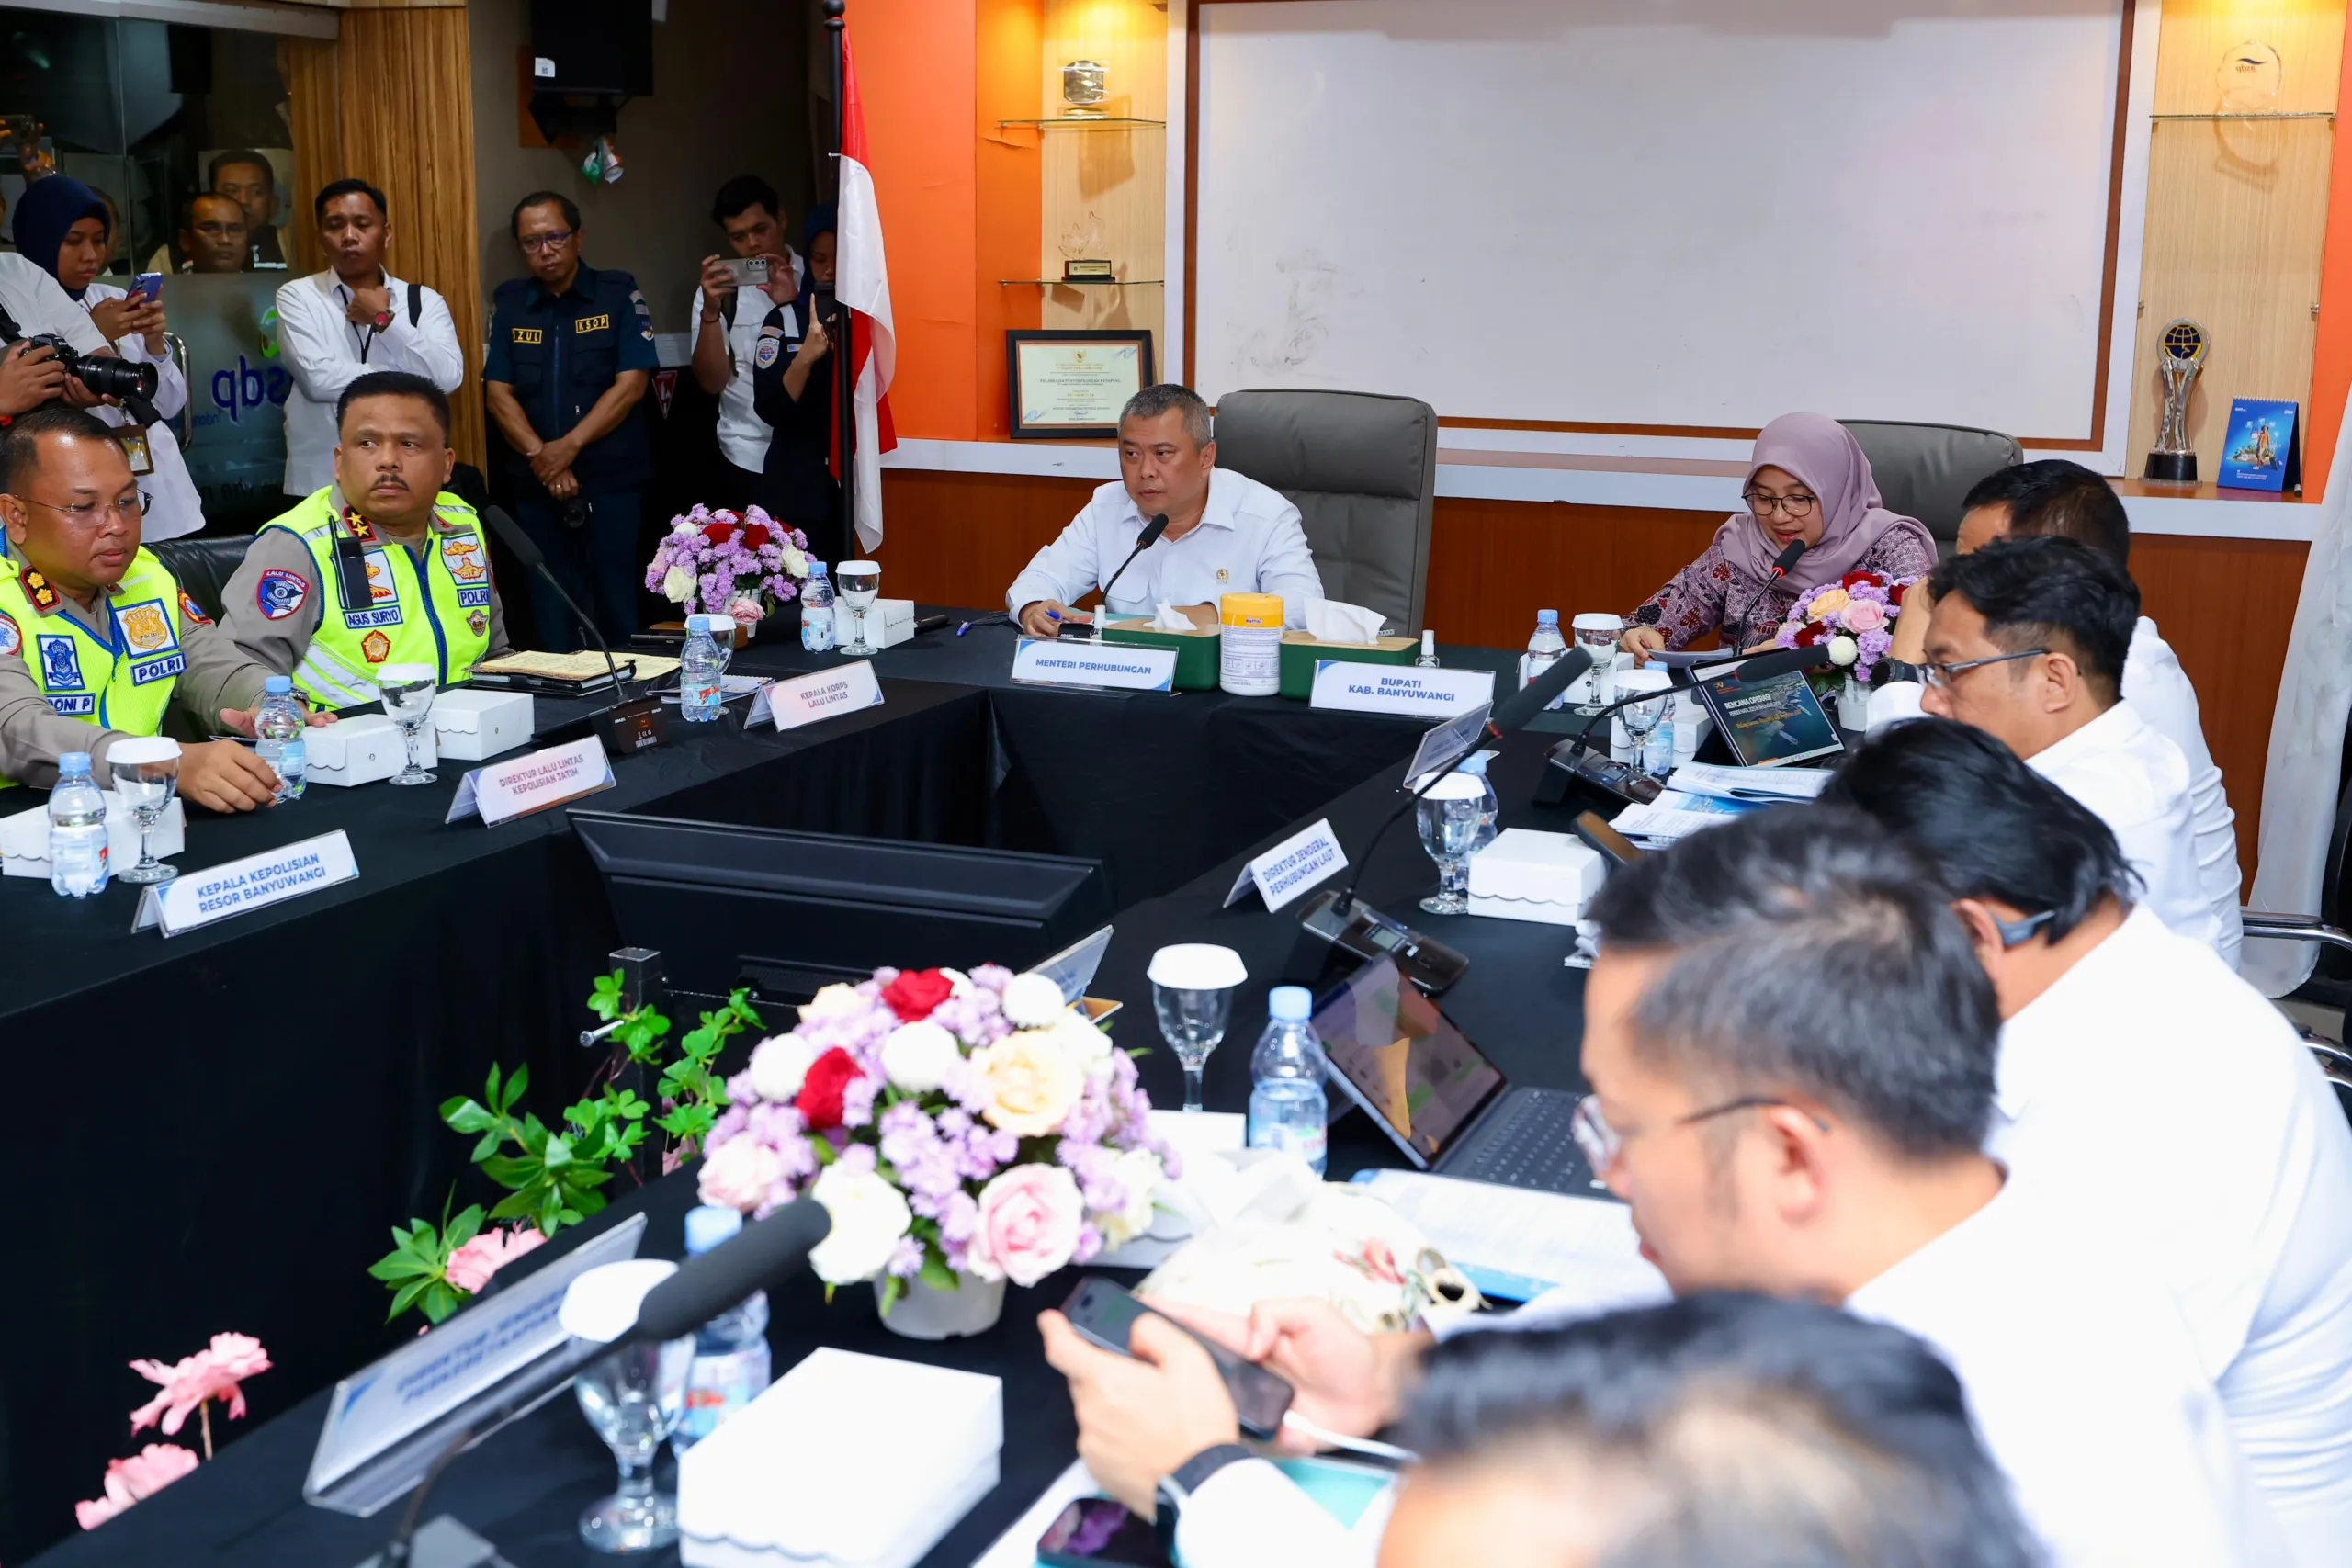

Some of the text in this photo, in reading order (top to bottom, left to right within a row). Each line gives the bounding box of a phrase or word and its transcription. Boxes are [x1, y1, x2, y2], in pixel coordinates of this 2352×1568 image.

[578, 317, 606, 331] KSOP
[266, 570, 306, 588] LALU LINTAS
[348, 608, 399, 626] AGUS SURYO
[139, 657, 181, 681] POLRI
[1035, 659, 1152, 674] MENTERI PERHUBUNGAN
[800, 682, 849, 700] KEPALA KORPS
[1380, 677, 1421, 689] BUPATI
[808, 691, 848, 708] LALU LINTAS
[1348, 684, 1454, 702] KAB. BANYUWANGI
[1724, 698, 1749, 709] RENCANA
[1748, 694, 1771, 705] OPERASI
[82, 697, 91, 710] P
[499, 754, 584, 787] DIREKTUR LALU LINTAS
[513, 768, 580, 795] KEPOLISIAN JATIM
[1262, 836, 1329, 882] DIREKTUR JENDERAL
[197, 853, 320, 898] KEPALA KEPOLISIAN
[1269, 848, 1336, 897] PERHUBUNGAN LAUT
[199, 866, 326, 914] RESOR BANYUWANGI
